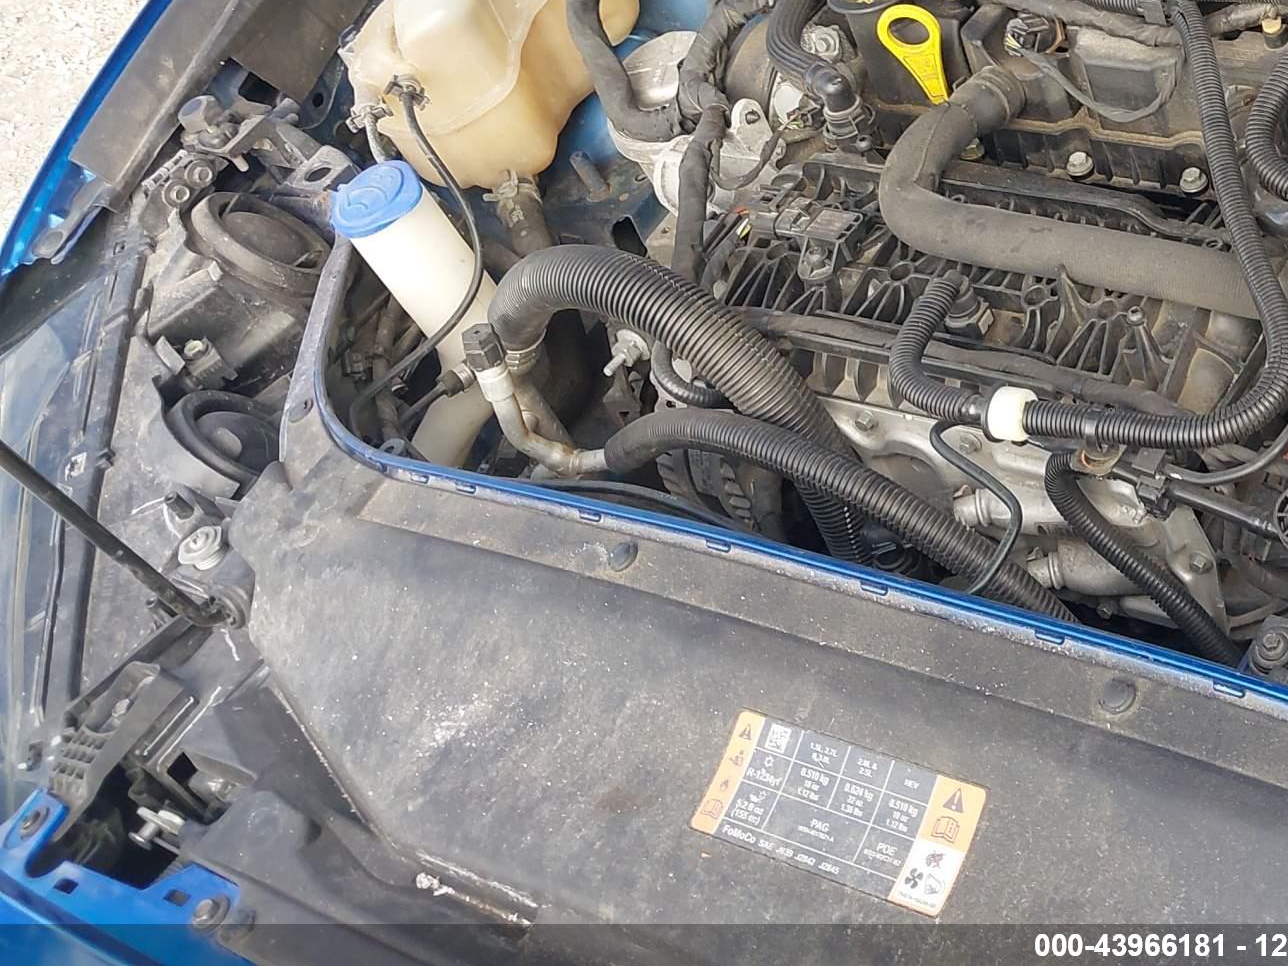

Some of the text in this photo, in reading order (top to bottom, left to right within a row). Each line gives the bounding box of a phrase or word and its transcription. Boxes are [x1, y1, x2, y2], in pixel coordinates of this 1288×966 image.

[817, 774, 830, 786] kg
[862, 789, 875, 802] kg
[906, 804, 919, 818] kg
[809, 817, 830, 832] PAG
[721, 823, 757, 843] FoMoCo
[757, 839, 774, 851] SAE
[875, 841, 898, 856] POE
